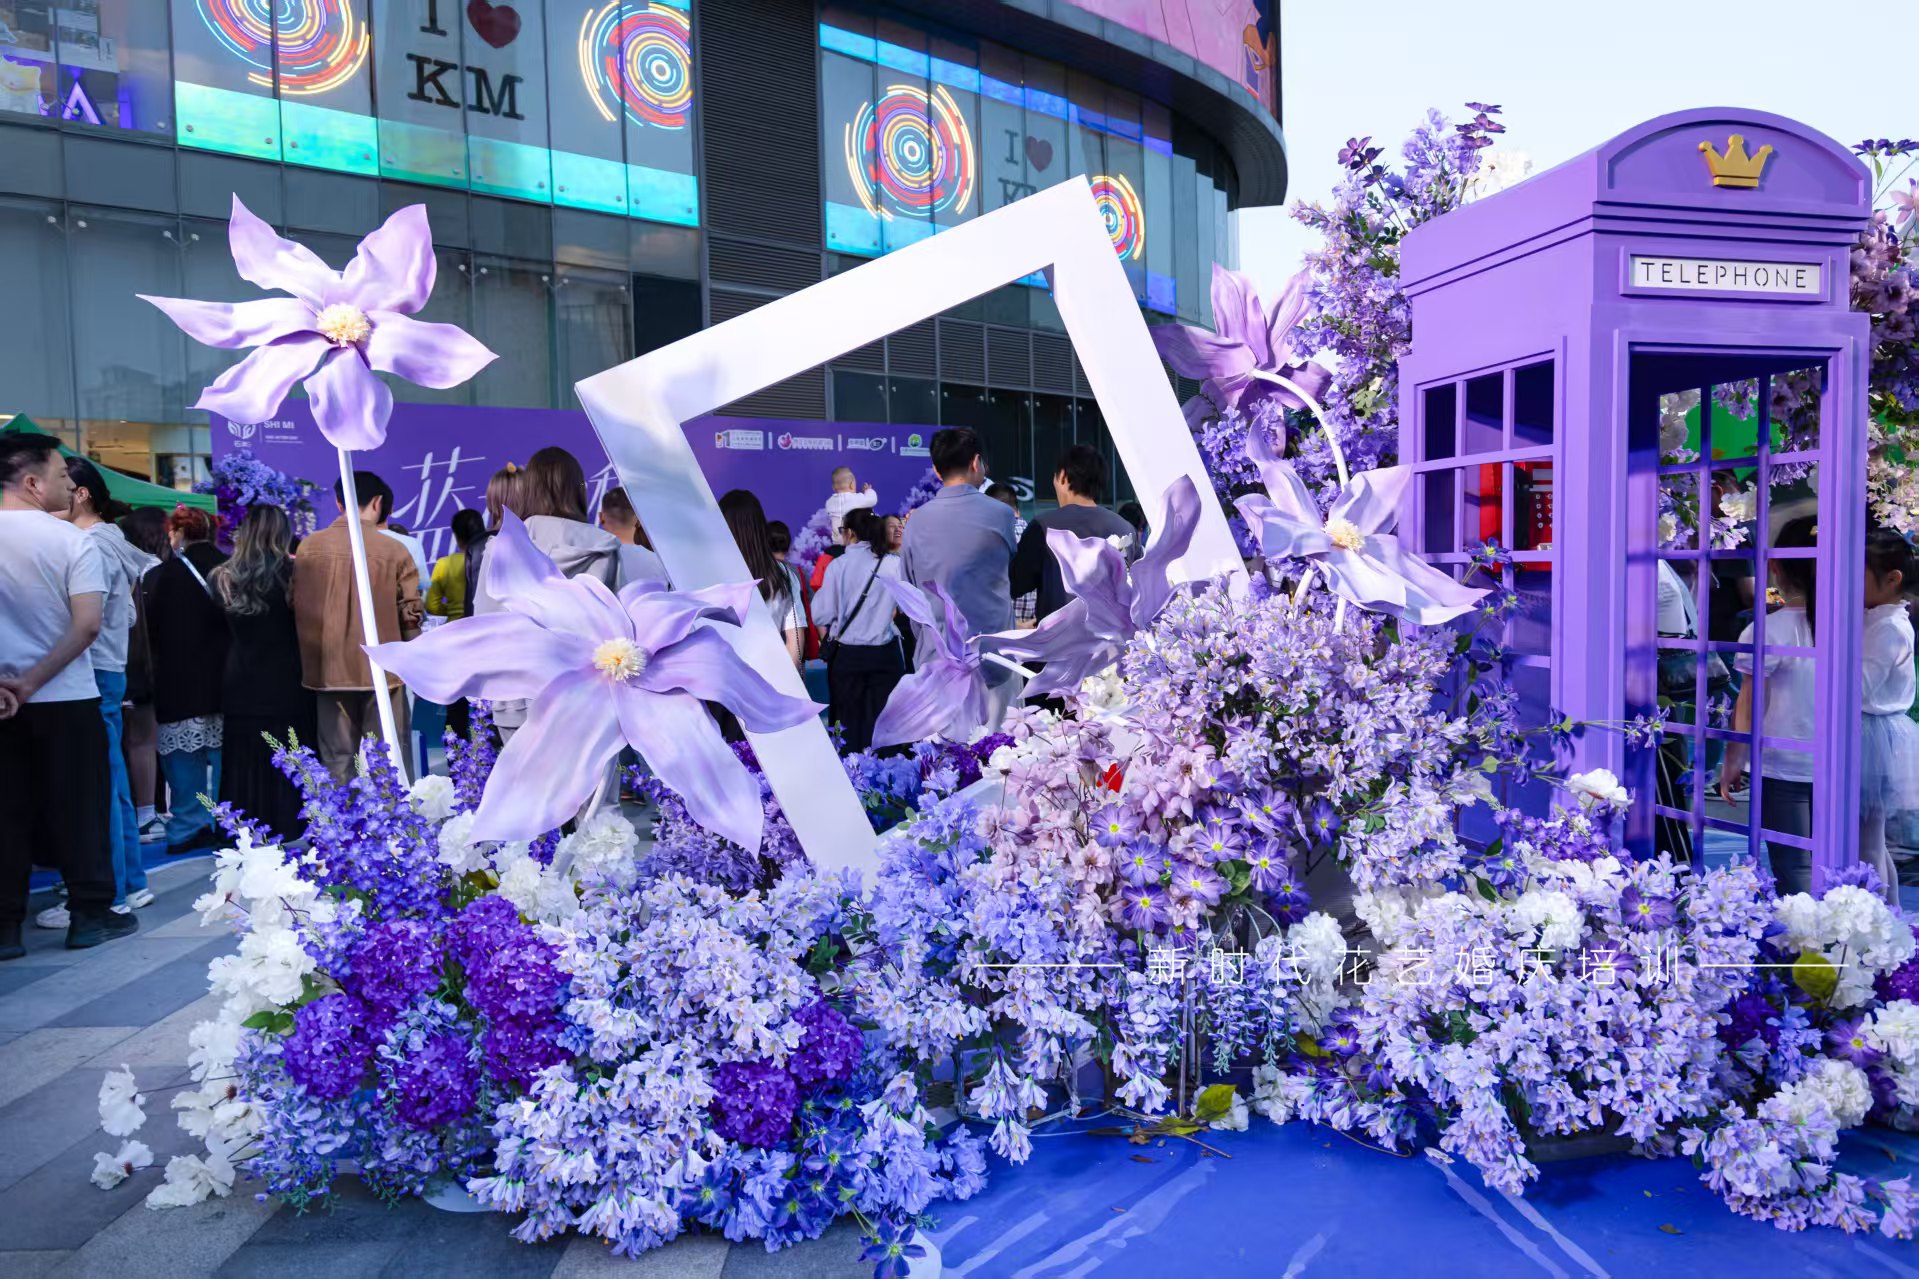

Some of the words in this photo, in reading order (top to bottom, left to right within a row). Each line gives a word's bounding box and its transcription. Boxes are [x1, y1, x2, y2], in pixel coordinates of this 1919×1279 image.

[405, 52, 525, 121] KM
[1004, 129, 1019, 166] I
[998, 177, 1038, 209] K
[1640, 261, 1806, 289] TELEPHONE
[263, 420, 281, 429] SHI
[282, 421, 295, 429] MI
